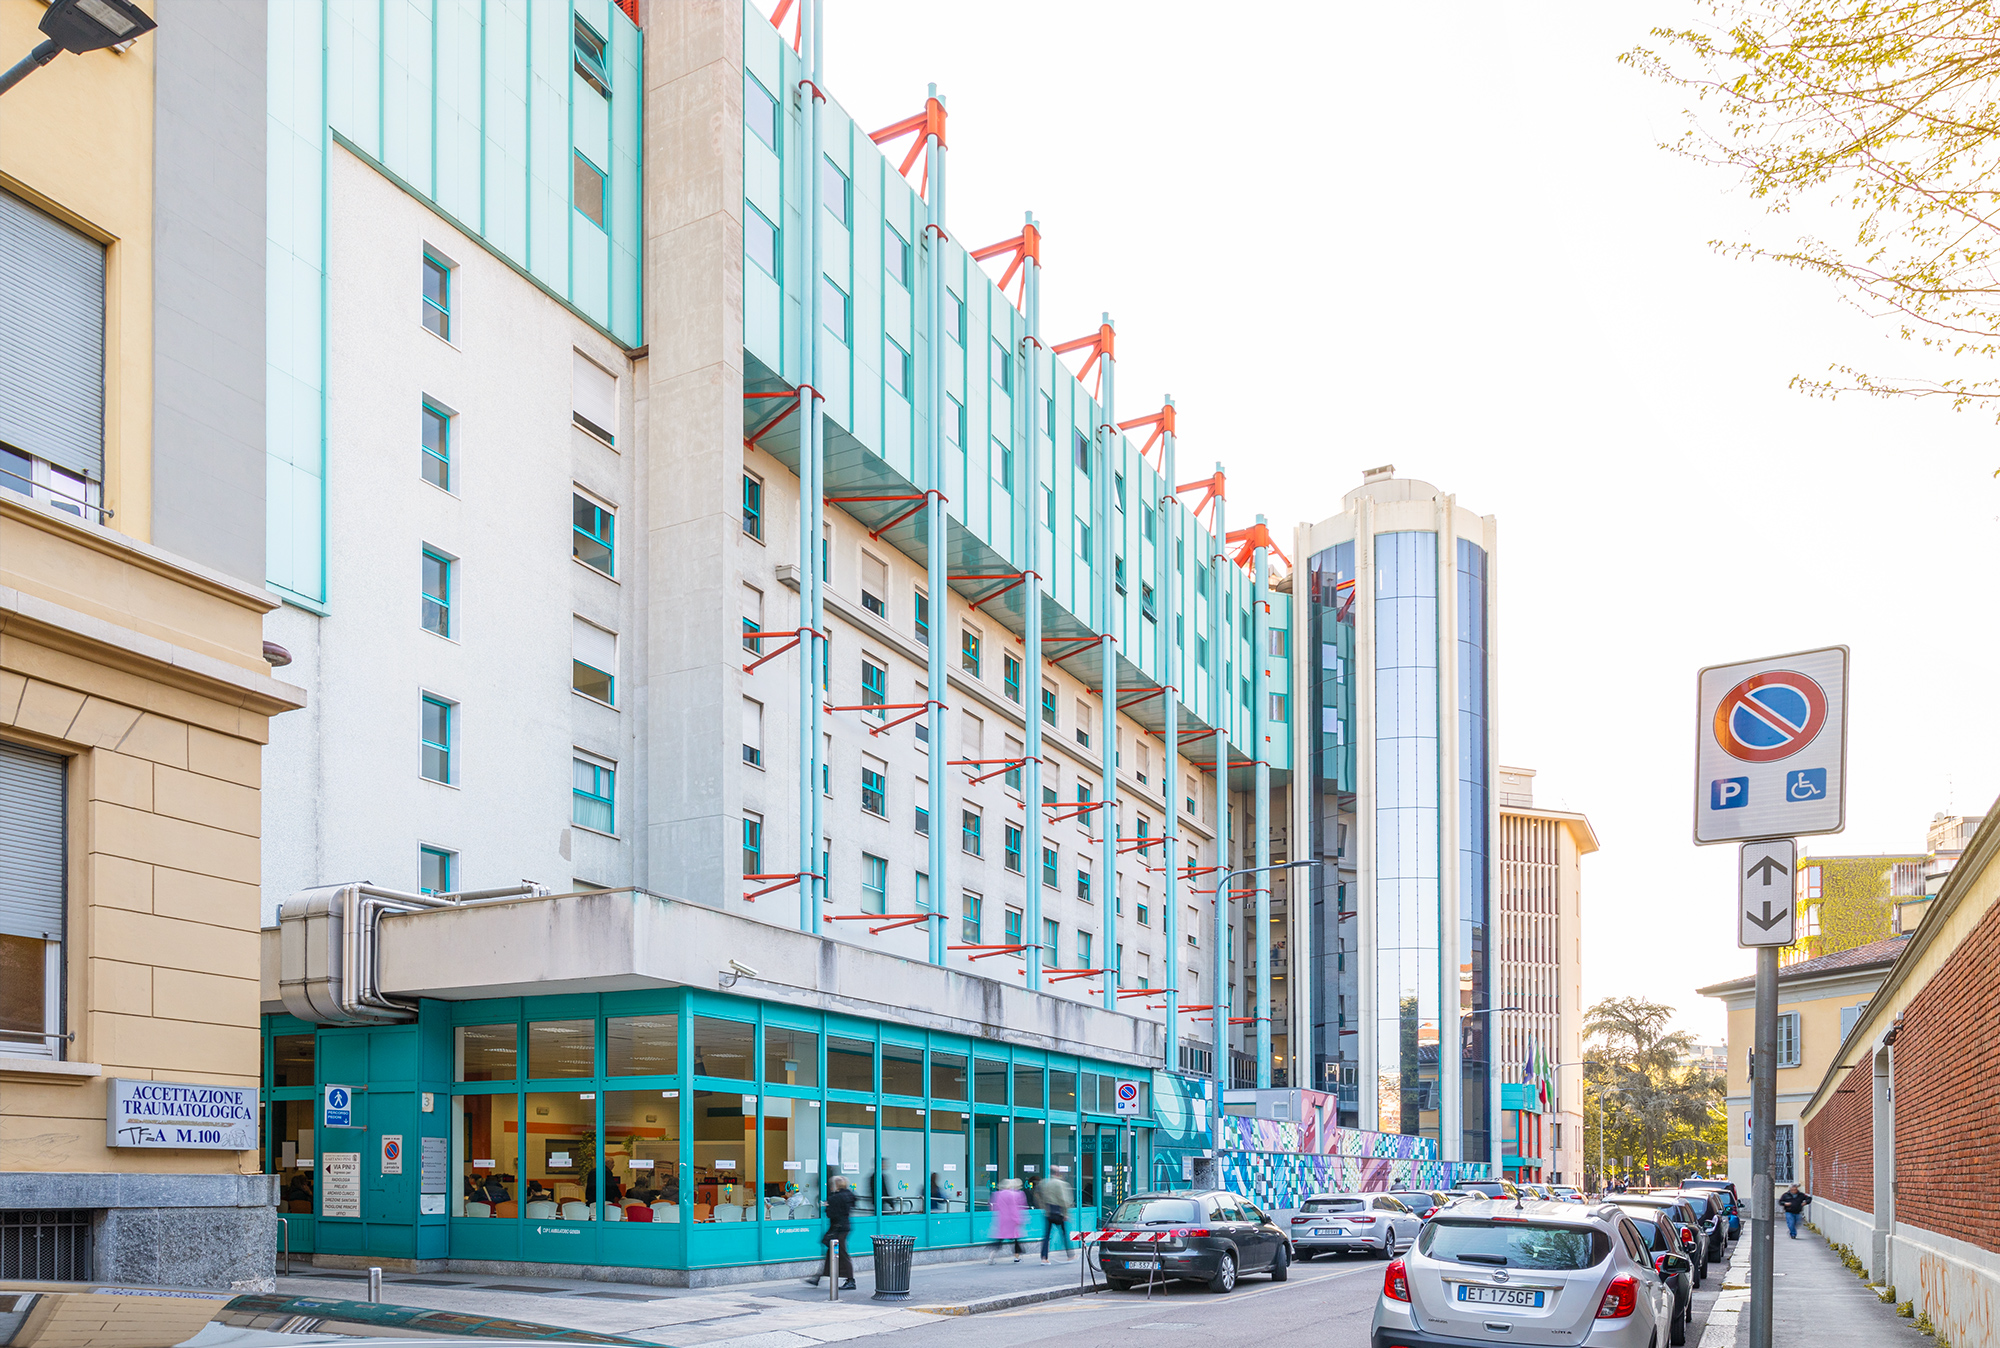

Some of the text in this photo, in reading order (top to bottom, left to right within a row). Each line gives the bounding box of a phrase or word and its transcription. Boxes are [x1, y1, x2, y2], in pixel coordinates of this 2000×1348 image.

[1720, 782, 1741, 806] P
[132, 1085, 244, 1105] ACCETTAZIONE
[424, 1096, 430, 1106] 3
[123, 1100, 251, 1120] TRAUMATOLOGICA
[155, 1129, 166, 1142] A
[176, 1129, 220, 1144] M.100
[1467, 1287, 1485, 1300] ET
[1491, 1289, 1534, 1304] 175GF
